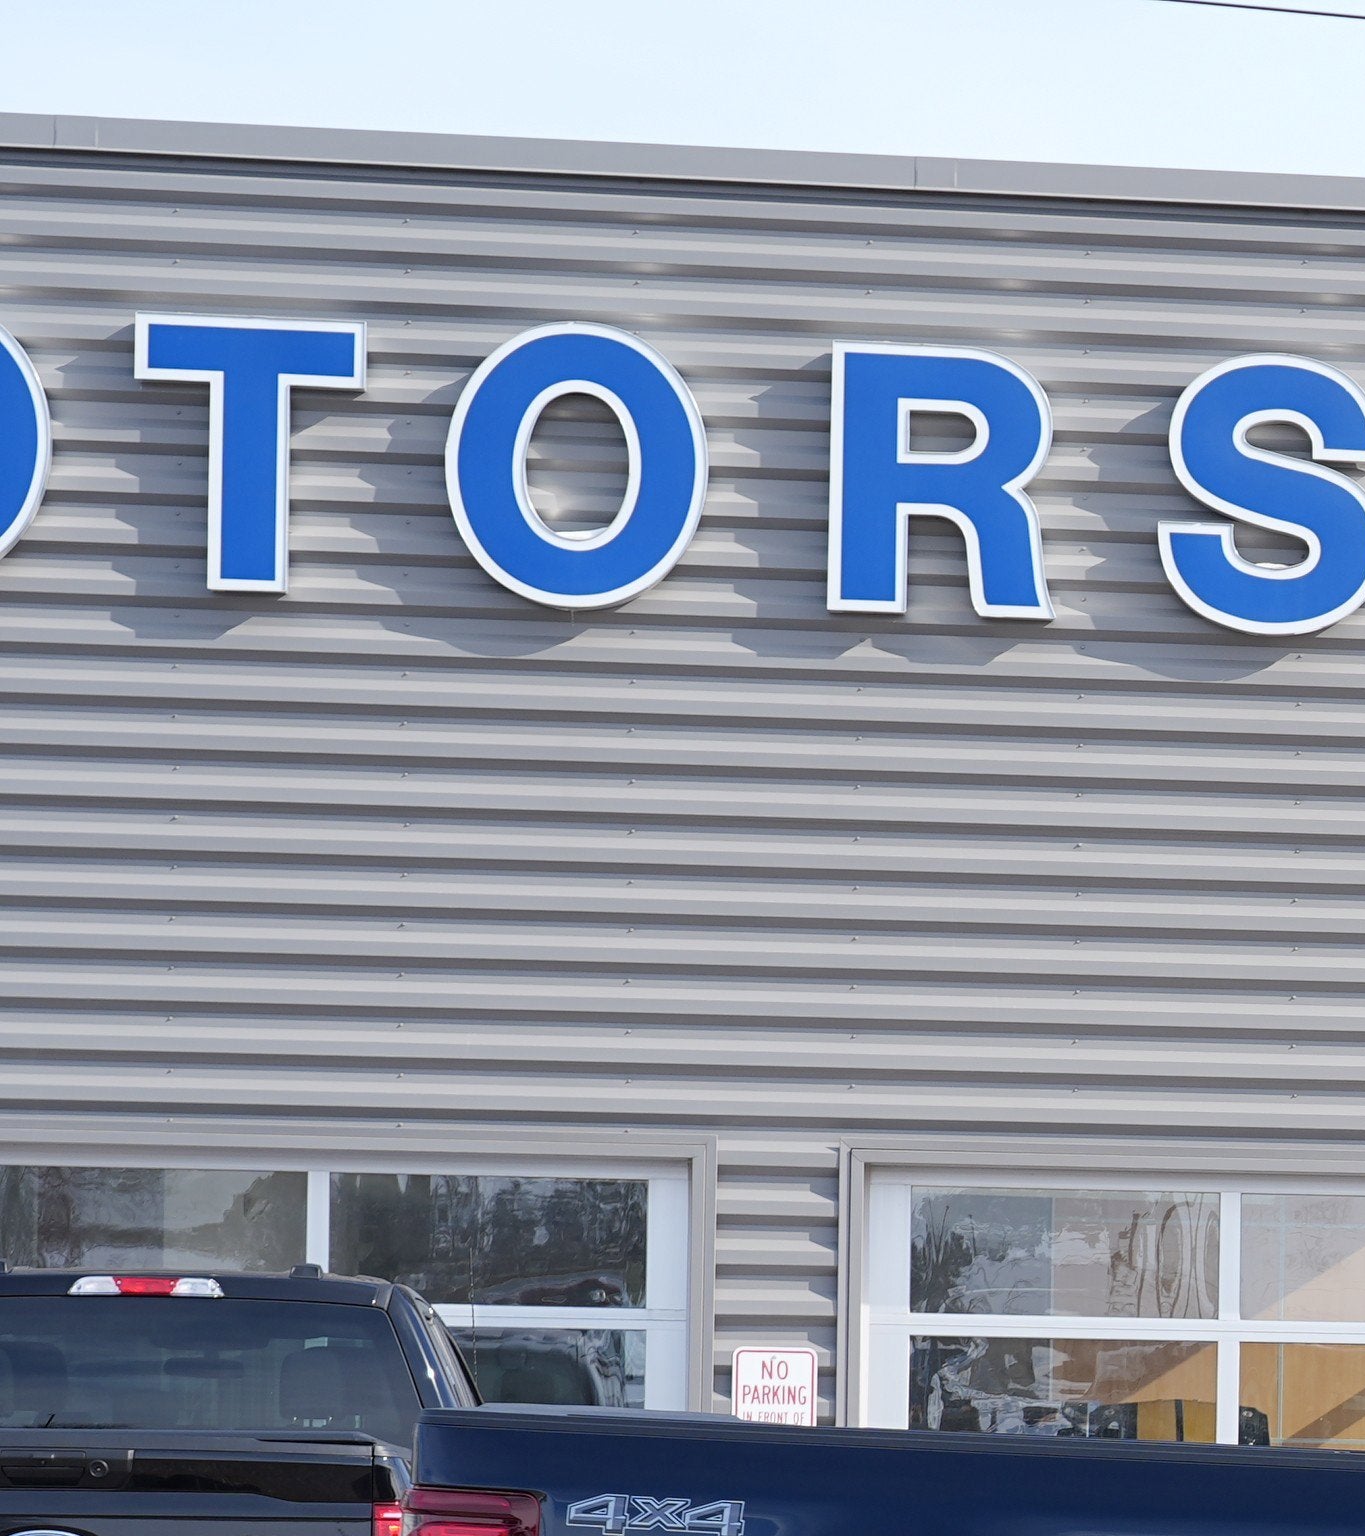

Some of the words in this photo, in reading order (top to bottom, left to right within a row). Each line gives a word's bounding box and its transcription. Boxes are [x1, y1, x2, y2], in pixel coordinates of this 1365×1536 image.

[761, 1360, 788, 1380] NO
[742, 1385, 807, 1405] PARKING
[758, 1411, 788, 1424] FRONT
